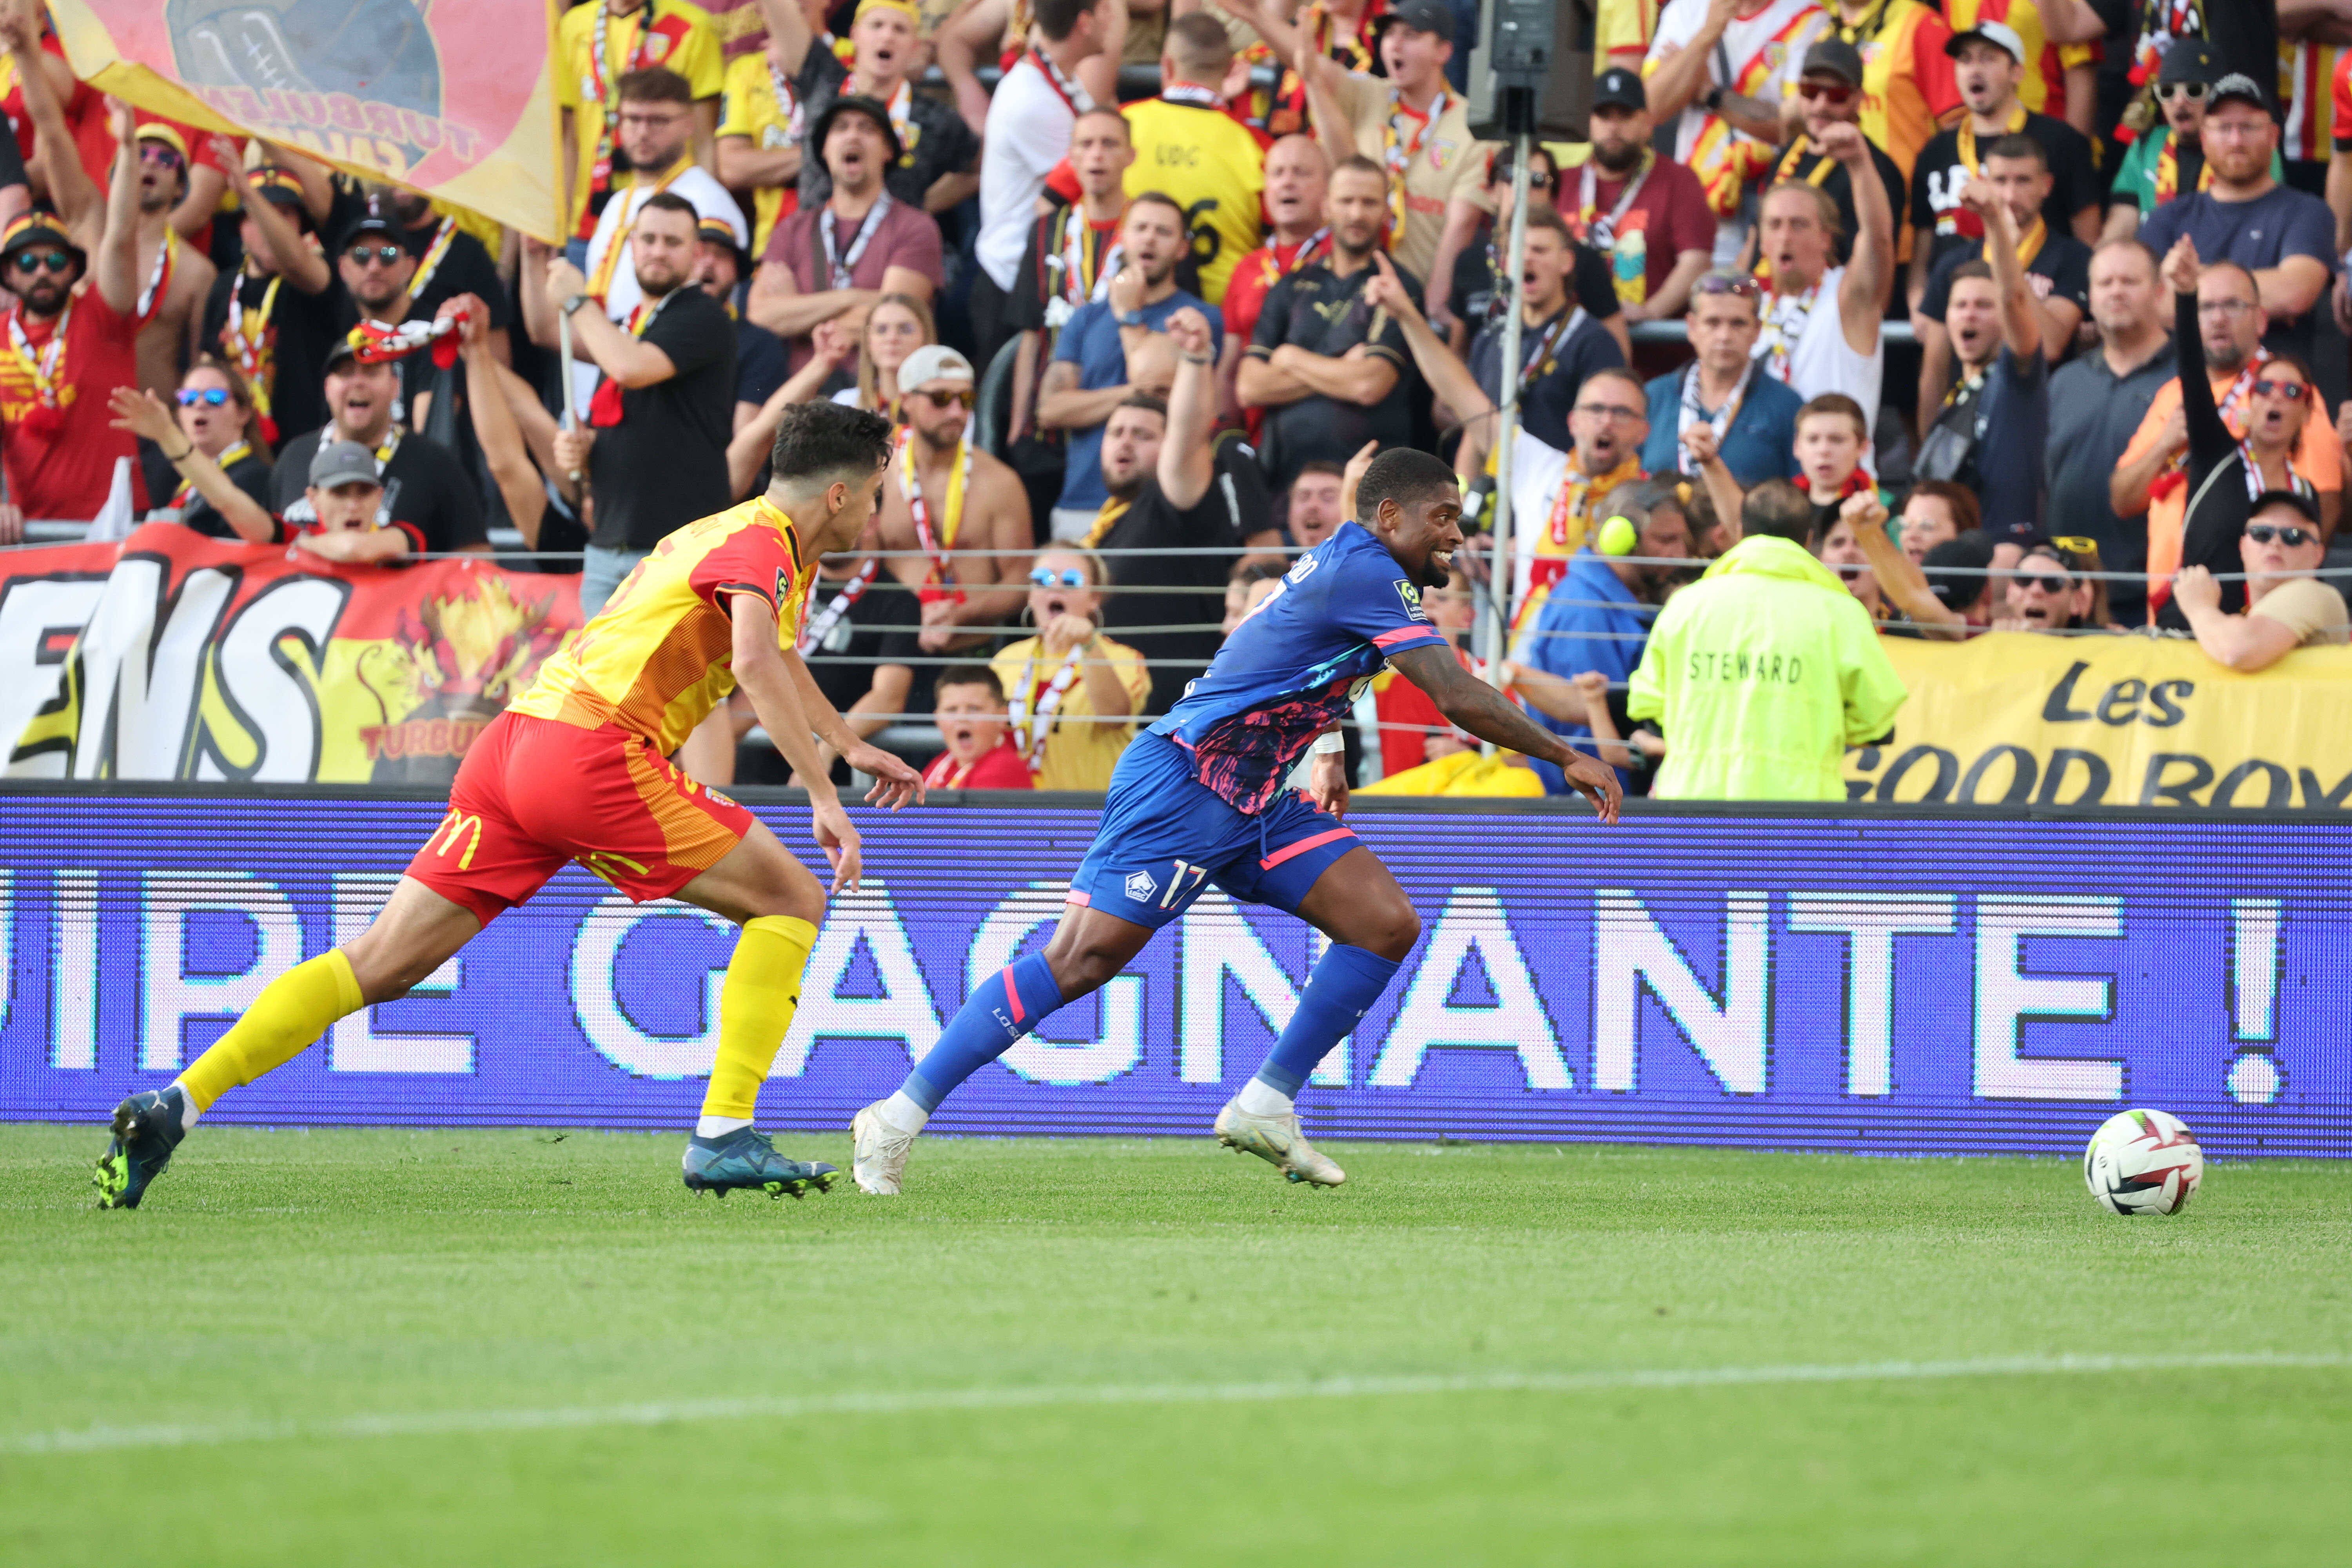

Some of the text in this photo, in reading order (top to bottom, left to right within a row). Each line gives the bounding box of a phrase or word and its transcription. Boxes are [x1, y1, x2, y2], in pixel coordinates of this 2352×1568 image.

[1690, 652, 1802, 684] STEWARD
[2043, 659, 2194, 727] Les
[361, 720, 491, 760] TURBU
[1128, 889, 1146, 900] LOSC
[1159, 859, 1208, 911] 17
[0, 869, 476, 1074] IPE
[571, 877, 2125, 1101] GAGNANTE
